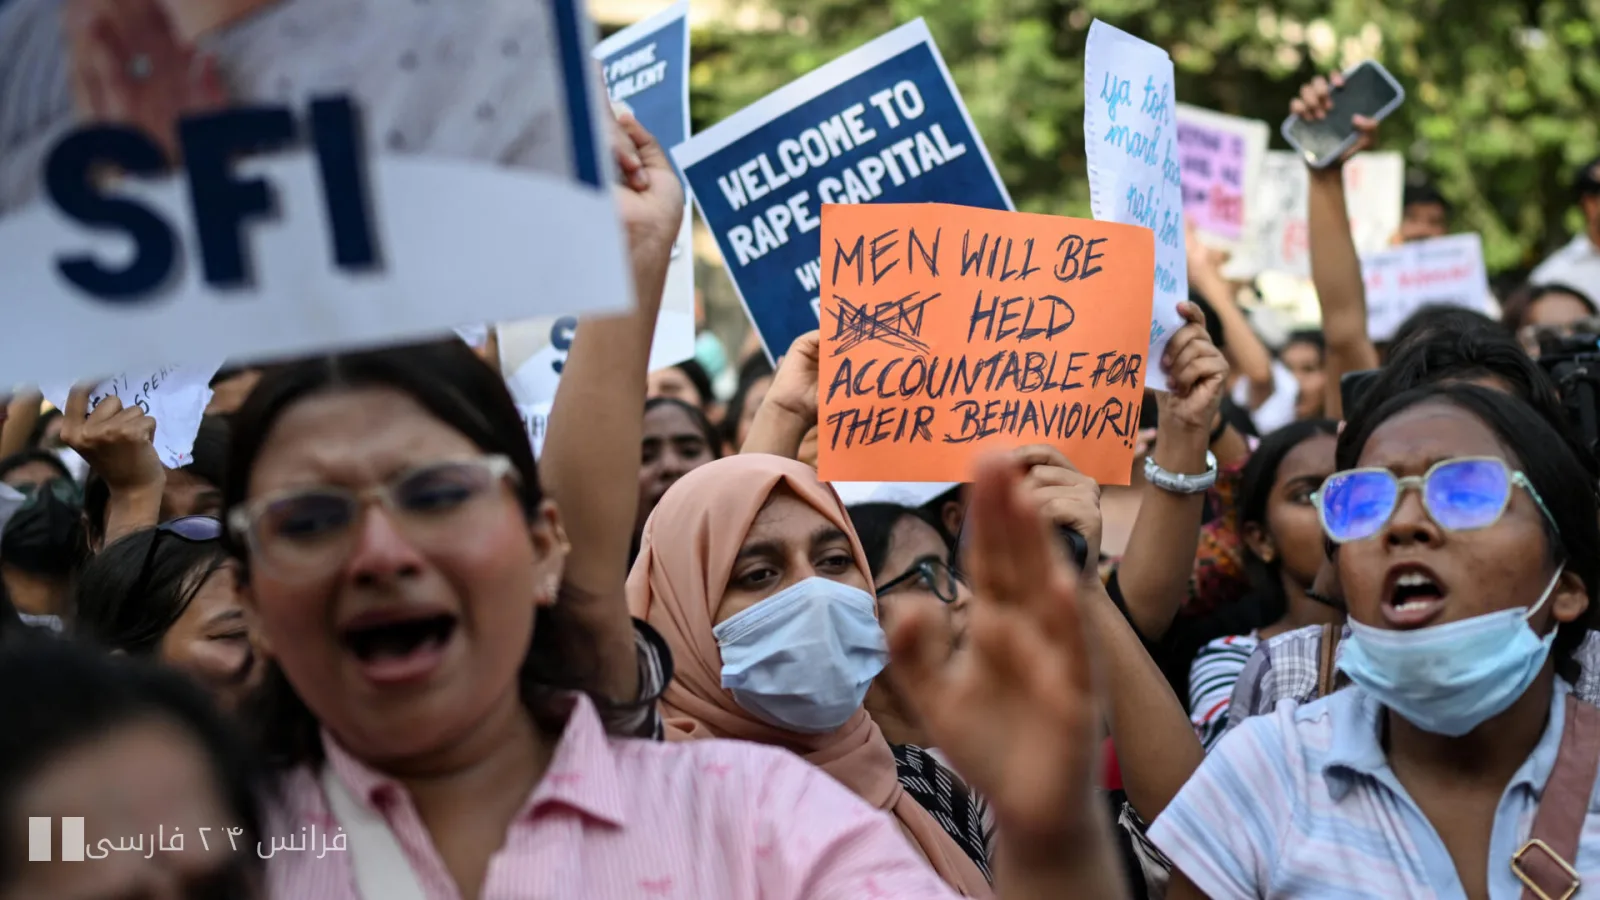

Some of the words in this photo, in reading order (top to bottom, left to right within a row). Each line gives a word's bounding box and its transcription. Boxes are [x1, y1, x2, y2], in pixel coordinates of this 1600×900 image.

[1100, 71, 1132, 122] ya
[1140, 74, 1170, 126] toh
[717, 103, 877, 211] WELCOME
[869, 80, 925, 129] TO
[43, 93, 385, 307] SFI
[727, 191, 820, 267] RAPE
[818, 123, 966, 205] CAPITAL
[832, 227, 941, 286] MEN
[960, 229, 1040, 282] WILL
[1054, 234, 1108, 282] BE
[967, 290, 1075, 343] HELD
[826, 350, 1089, 404] ACCOUNTABLE
[1089, 350, 1142, 389] FOR
[826, 405, 935, 451] THEIR
